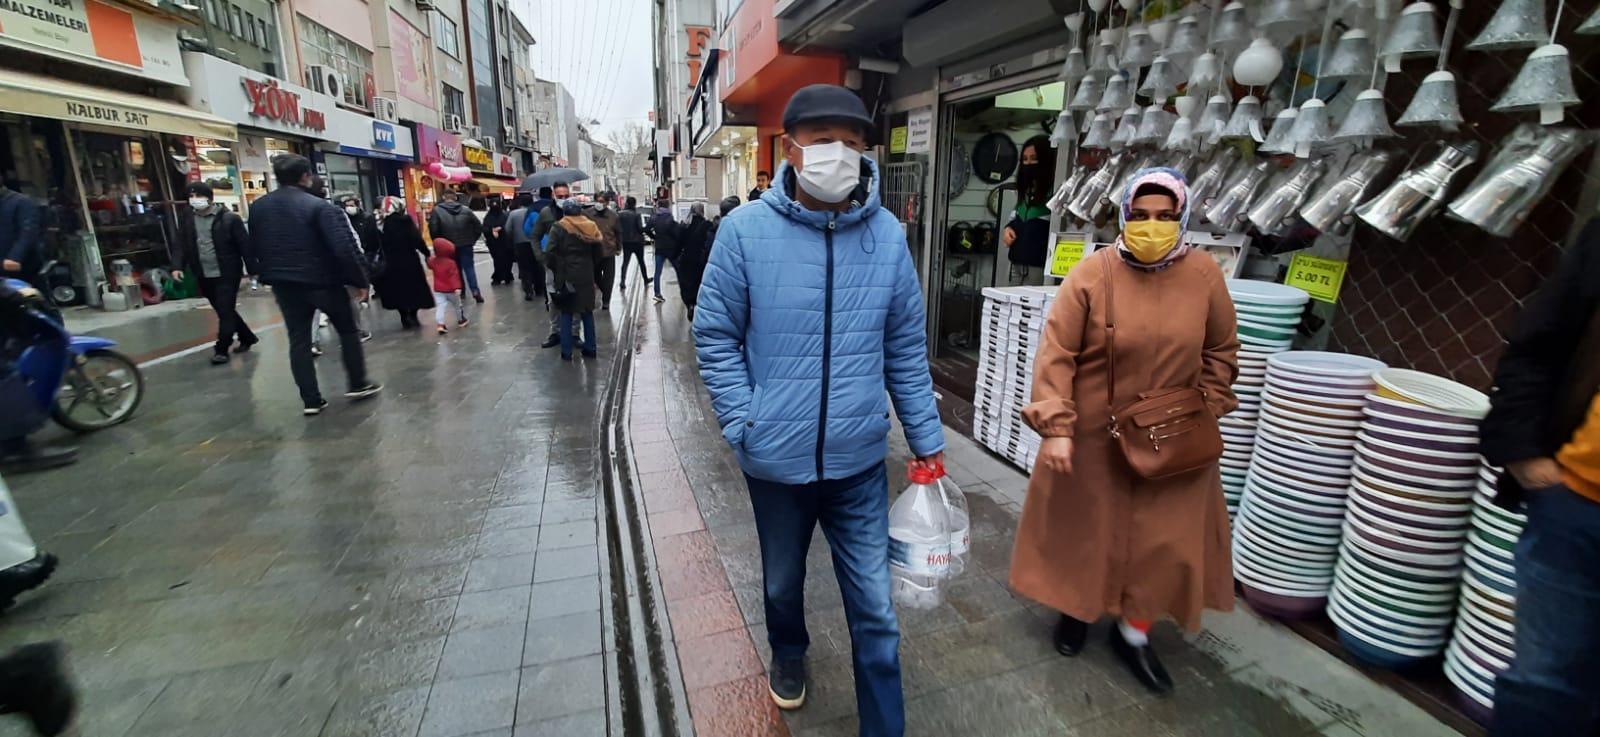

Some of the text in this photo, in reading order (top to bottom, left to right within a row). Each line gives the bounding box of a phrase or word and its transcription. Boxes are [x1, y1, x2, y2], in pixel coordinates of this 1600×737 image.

[0, 1, 88, 34] MALZEMELERİ
[243, 78, 300, 126] YÖN
[66, 102, 120, 122] NALBUR
[375, 127, 393, 143] KVK
[1295, 270, 1332, 287] 5.00 TL
[927, 552, 951, 566] HAYA
